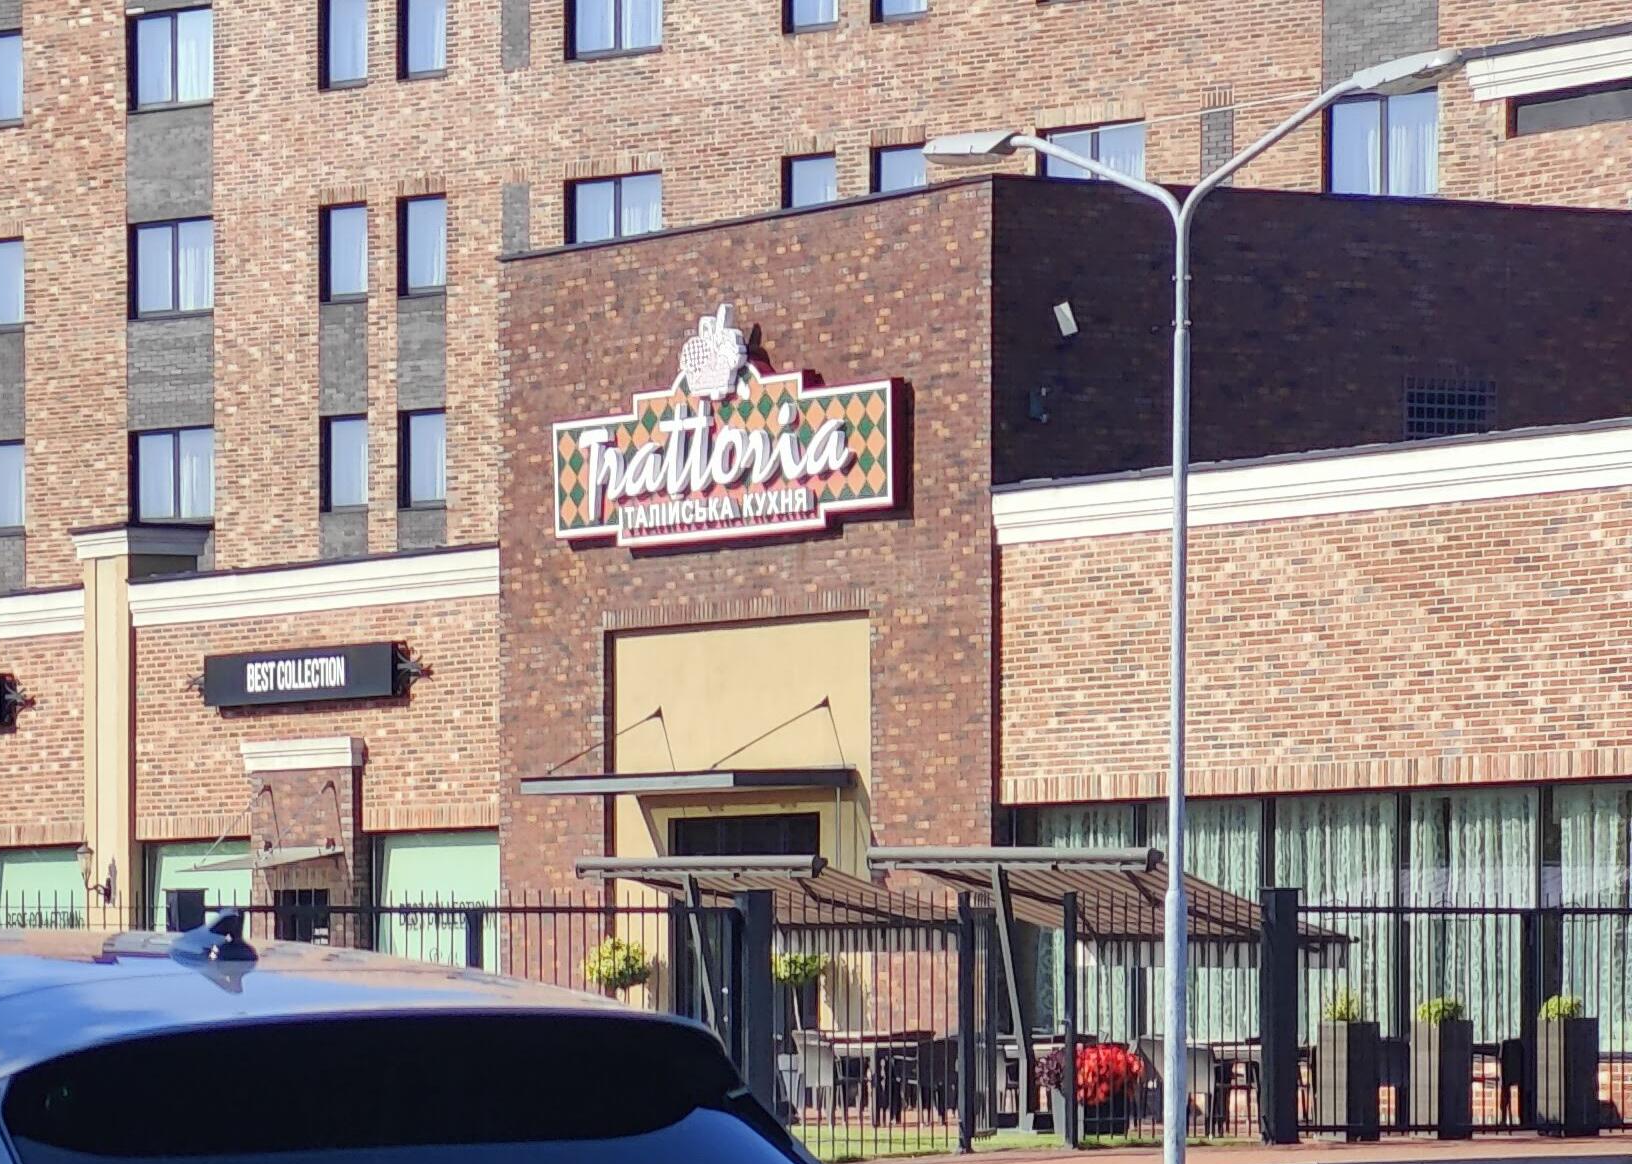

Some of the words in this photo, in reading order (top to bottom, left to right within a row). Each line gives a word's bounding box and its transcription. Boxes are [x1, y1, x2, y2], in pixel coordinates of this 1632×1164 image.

[578, 400, 852, 522] Trattoria
[618, 494, 735, 529] ІТАЛІЙСЬКА
[742, 487, 808, 517] КУХНЯ
[246, 661, 275, 693] BEST
[276, 655, 346, 690] COLLECTION
